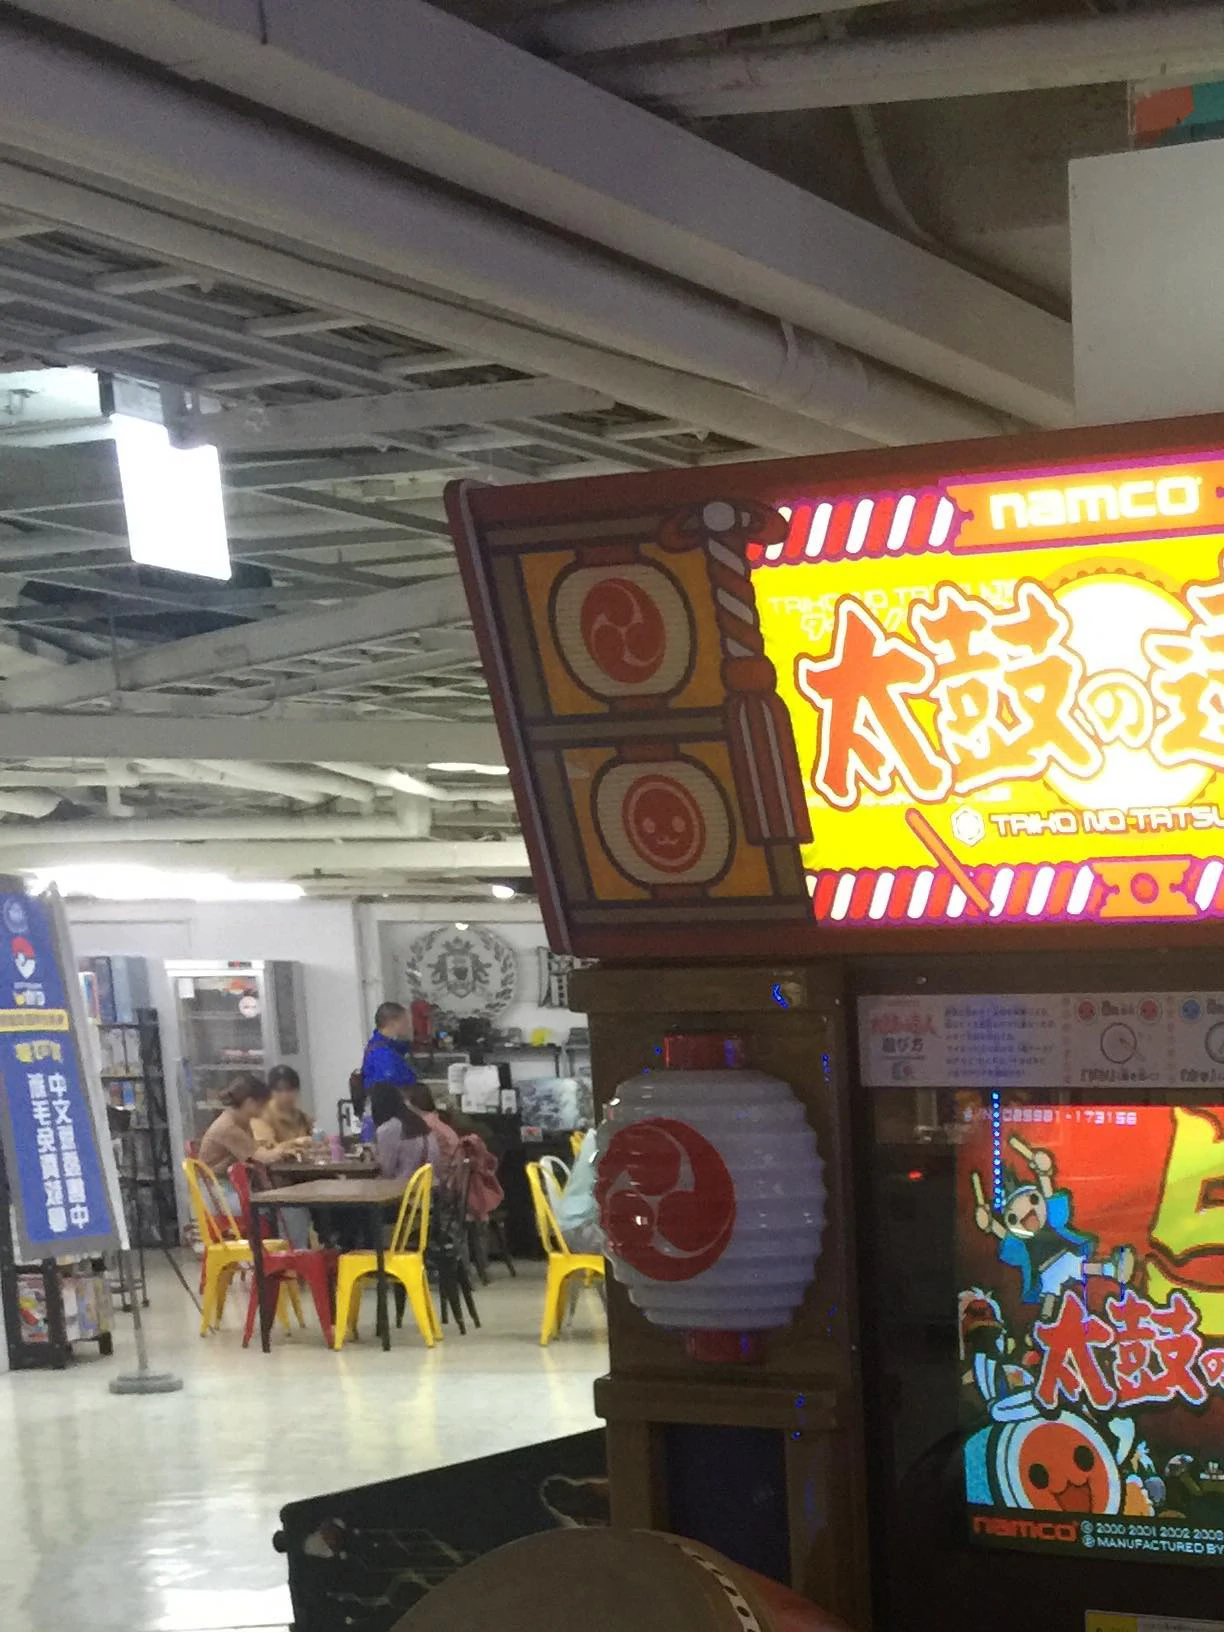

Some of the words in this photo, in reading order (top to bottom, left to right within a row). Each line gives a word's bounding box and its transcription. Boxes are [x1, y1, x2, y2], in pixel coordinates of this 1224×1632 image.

[989, 475, 1201, 530] namco
[990, 810, 1078, 837] TAIKO
[1097, 1537, 1205, 1555] MANUFACTURED
